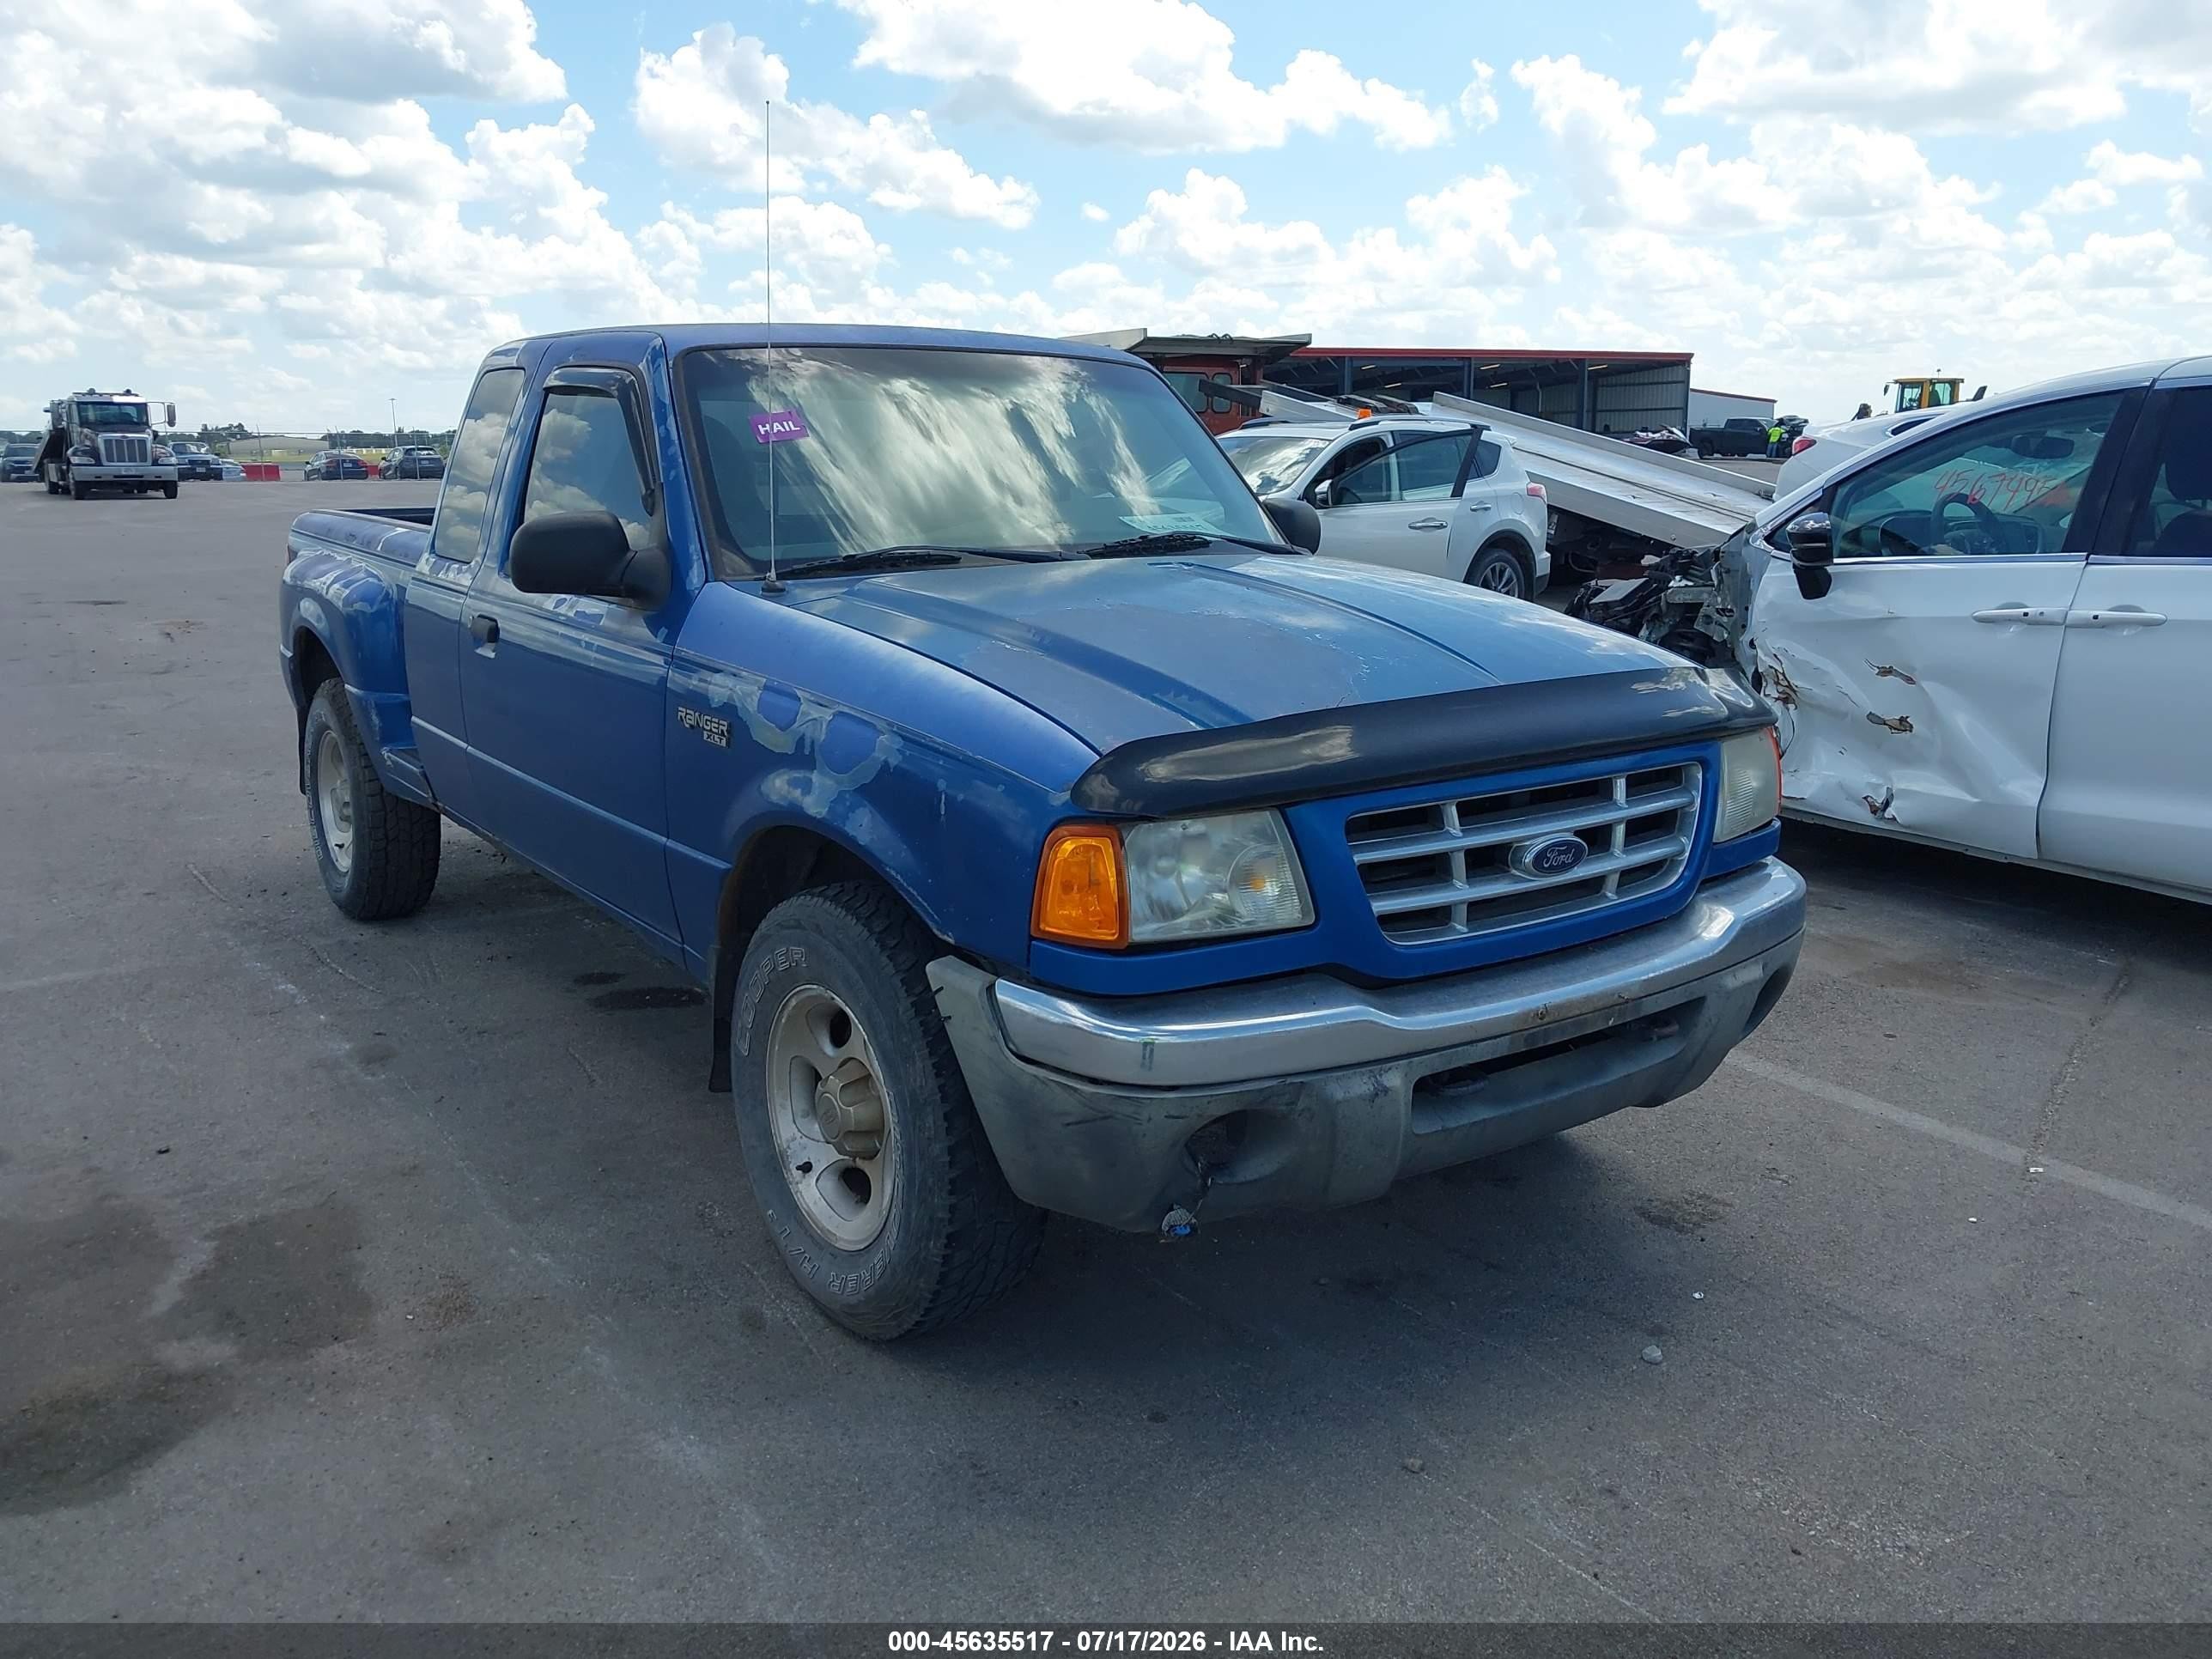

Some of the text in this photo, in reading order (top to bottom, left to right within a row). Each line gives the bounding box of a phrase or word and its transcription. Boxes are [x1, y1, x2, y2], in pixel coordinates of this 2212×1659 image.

[757, 421, 801, 434] HAIL
[678, 707, 728, 737] RANGER
[706, 732, 726, 745] XLT
[1543, 845, 1575, 867] Ford
[737, 946, 808, 1056] COOPER
